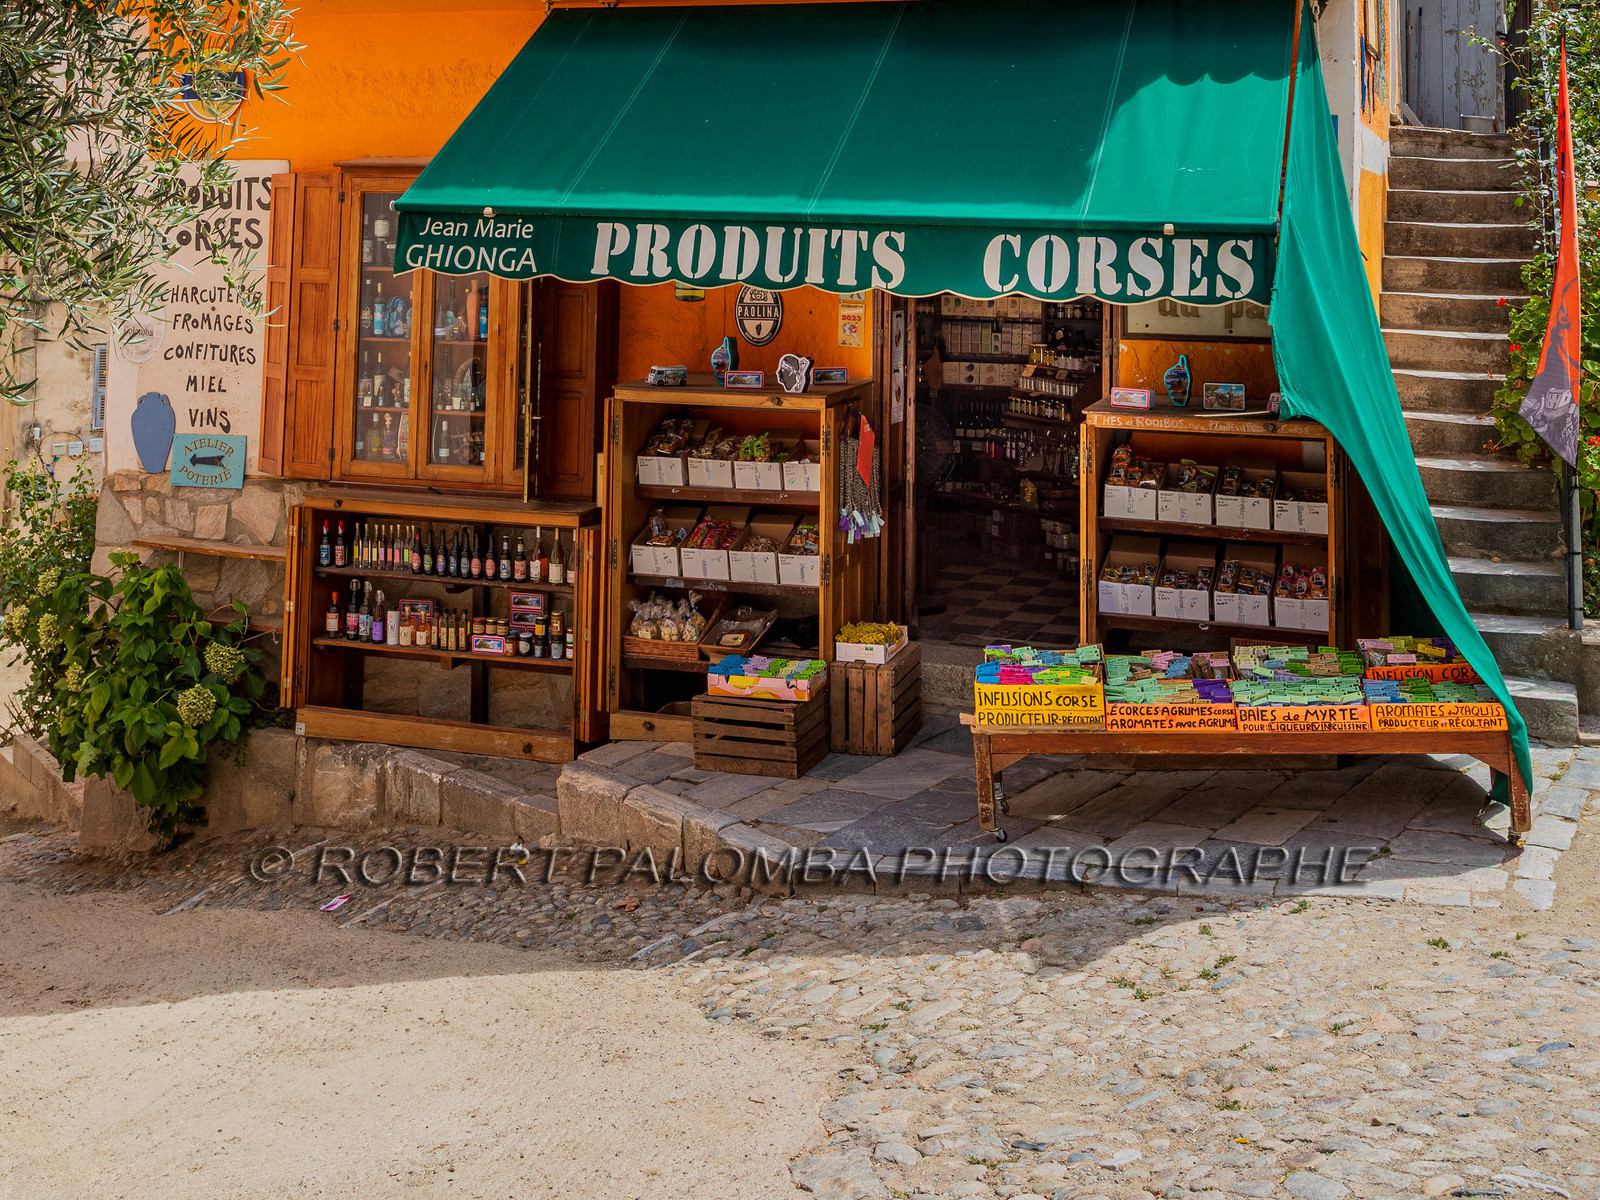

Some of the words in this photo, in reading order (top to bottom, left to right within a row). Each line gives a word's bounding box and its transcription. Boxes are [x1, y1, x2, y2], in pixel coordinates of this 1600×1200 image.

[420, 216, 468, 238] Jean
[474, 217, 534, 239] Marie
[406, 243, 538, 273] GHIONGA
[590, 222, 905, 289] PRODUITS
[983, 234, 1255, 298] CORSES
[738, 306, 779, 318] PAOLINA
[841, 314, 862, 322] 2023
[173, 312, 254, 335] FROMAGES
[163, 342, 257, 365] CONFITURES
[185, 375, 227, 394] MIEL
[188, 407, 232, 434] VINS
[184, 438, 235, 457] ATELIER
[178, 465, 232, 485] POTERIE
[1442, 667, 1479, 680] CORS
[1056, 696, 1097, 707] CORSE
[1375, 705, 1445, 717] AROMATES
[1304, 708, 1359, 721] MYRTE
[1379, 718, 1439, 728] PRODUCTEUR
